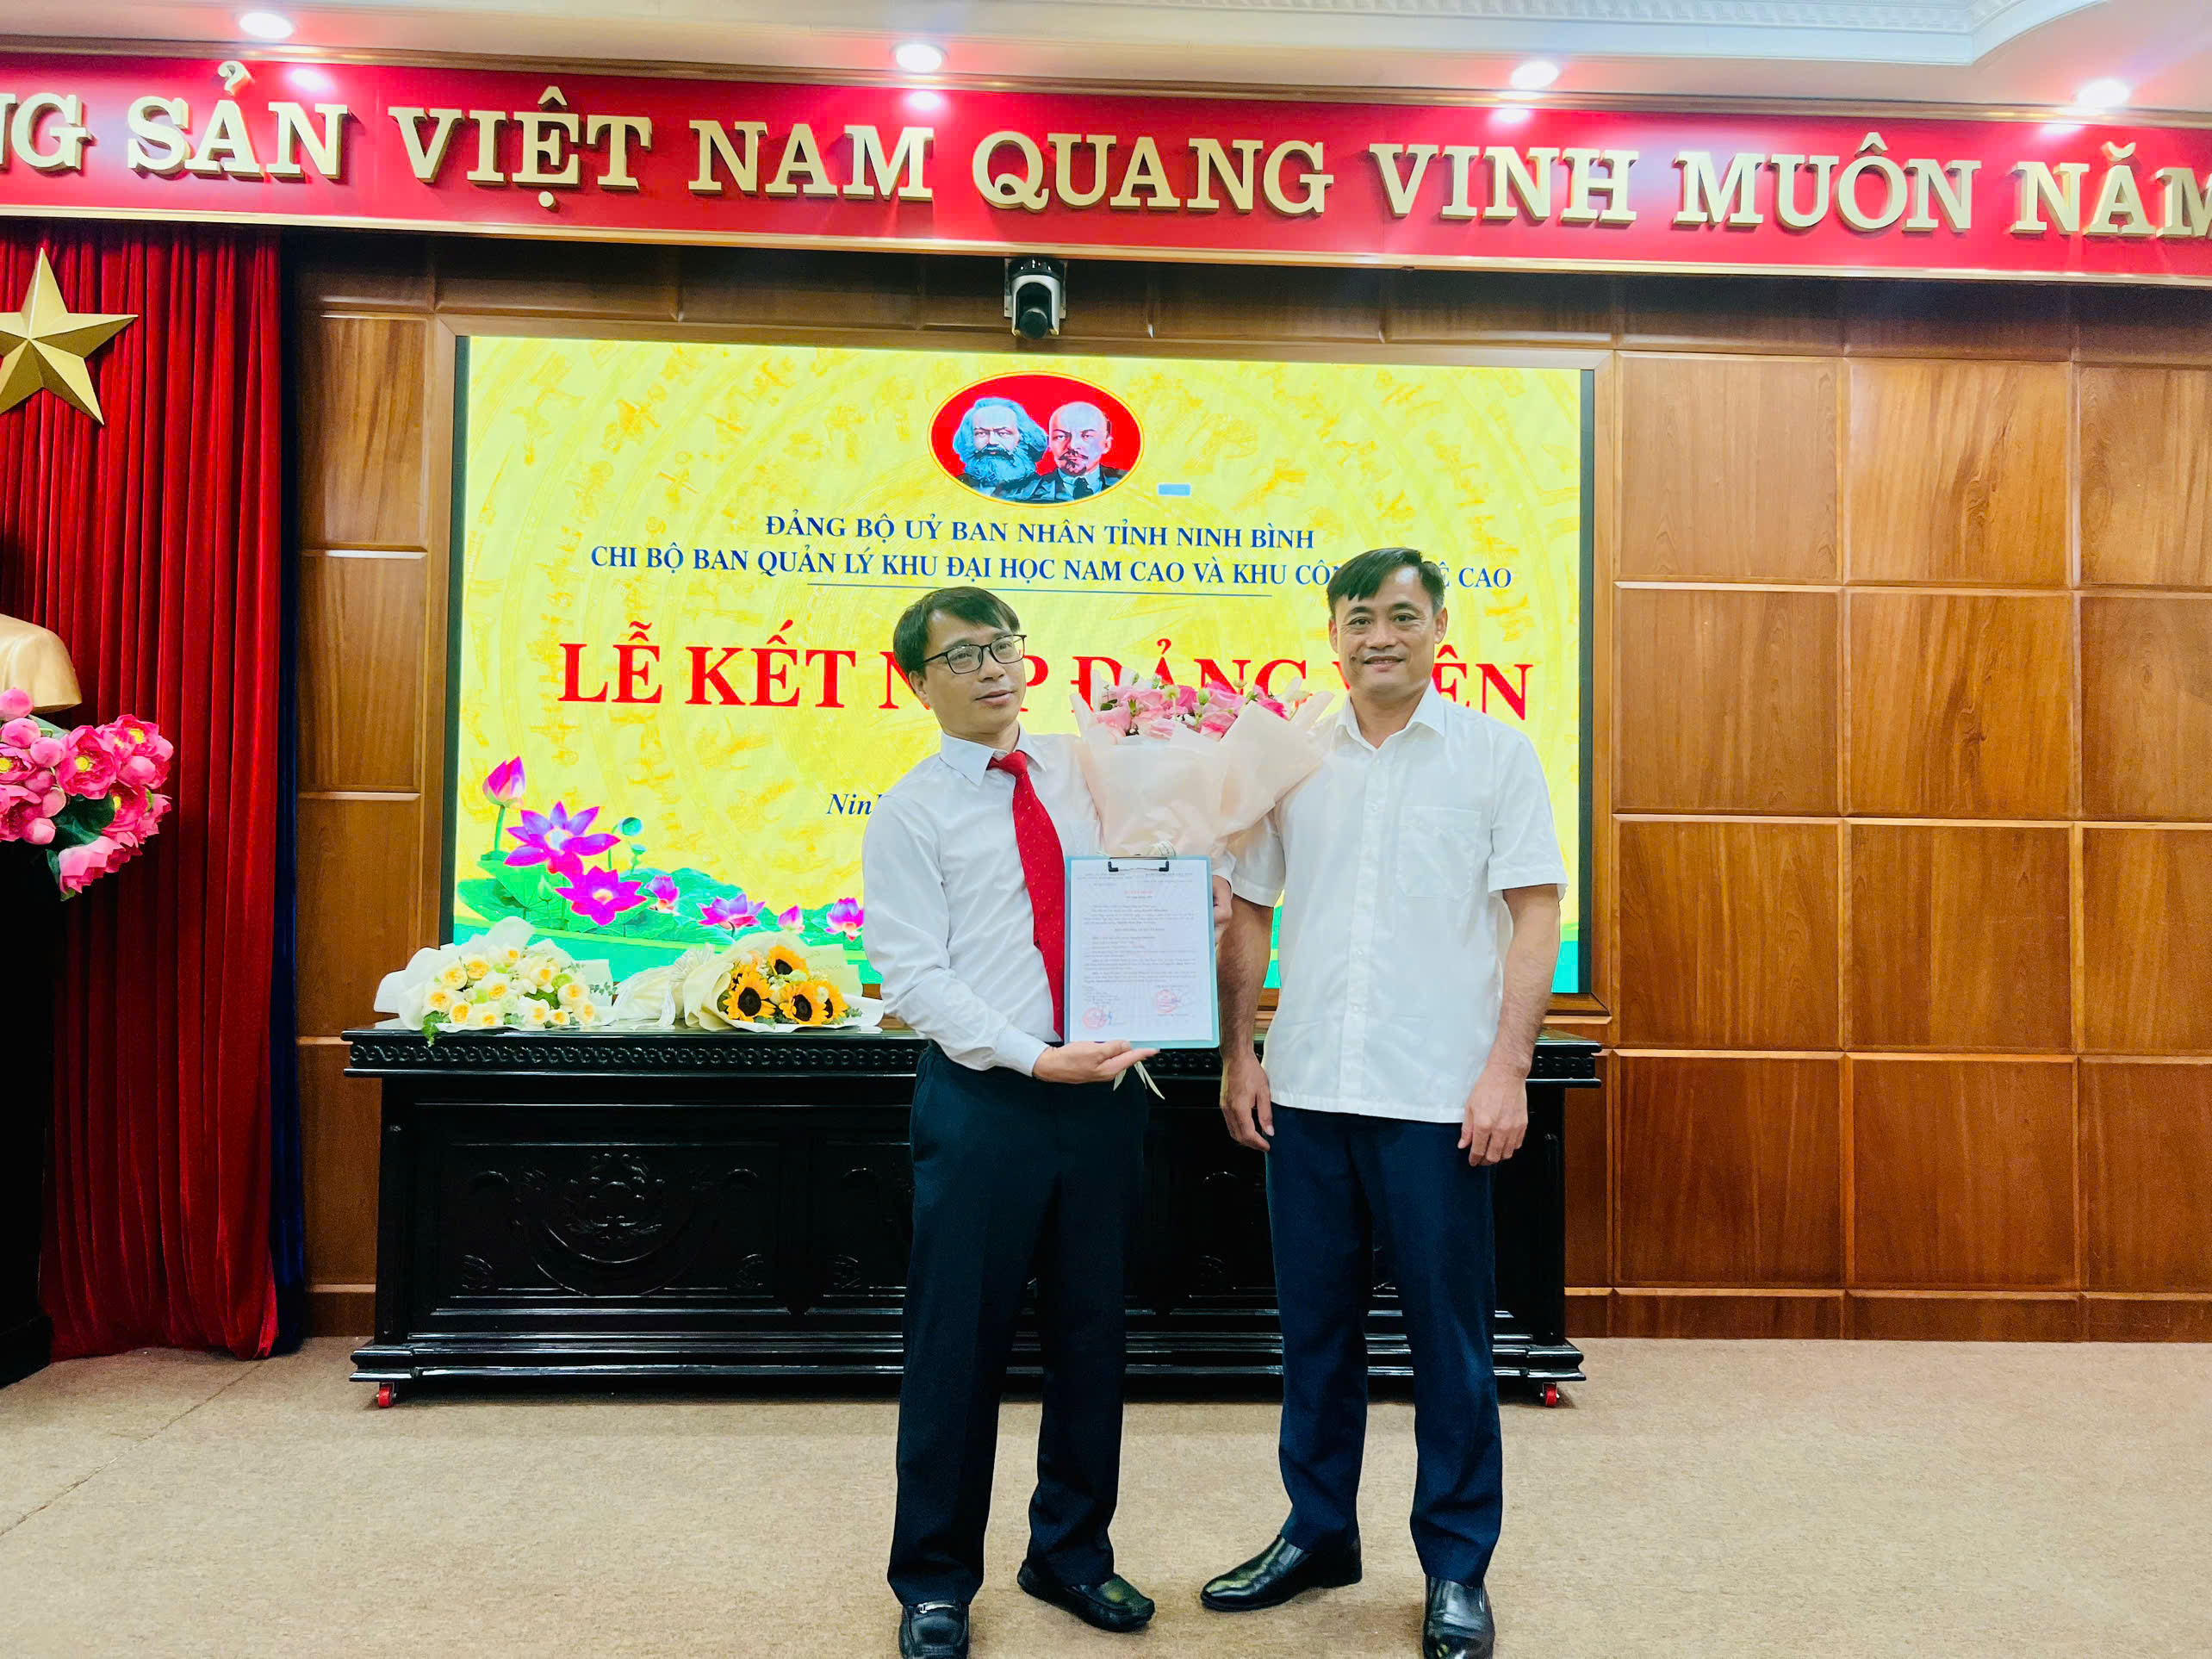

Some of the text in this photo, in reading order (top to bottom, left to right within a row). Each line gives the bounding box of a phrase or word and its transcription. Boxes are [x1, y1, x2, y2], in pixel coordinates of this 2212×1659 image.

[0, 92, 90, 172] G
[127, 60, 347, 179] SẢN
[388, 85, 652, 210] VIỆT
[689, 120, 934, 202] NAM
[972, 130, 1333, 215] QUANG
[1369, 143, 1638, 224] VINH
[1673, 131, 1980, 233] MUÔN
[766, 509, 1314, 550] ĐẢNG BỘ UỶ BAN NHÂN TỈNH NINH BÌNH
[591, 546, 637, 568] CHI
[647, 543, 684, 574] BỘ
[693, 550, 749, 571] BAN
[757, 545, 836, 577] QUẢN
[845, 548, 874, 575] LÝ
[882, 554, 938, 576] KHU
[947, 557, 991, 579] ĐẠI
[1000, 558, 1055, 584] HỌC
[1064, 559, 1122, 581] NAM
[1130, 561, 1185, 582] CAO
[1192, 556, 1224, 583] VÀ
[1233, 564, 1287, 585] KHU
[1295, 560, 1340, 586] CÔ
[1457, 568, 1513, 588] CAO
[557, 621, 663, 704] LỄ
[685, 619, 856, 709] KẾT
[878, 651, 1049, 713] NP
[826, 792, 882, 815] Nin
